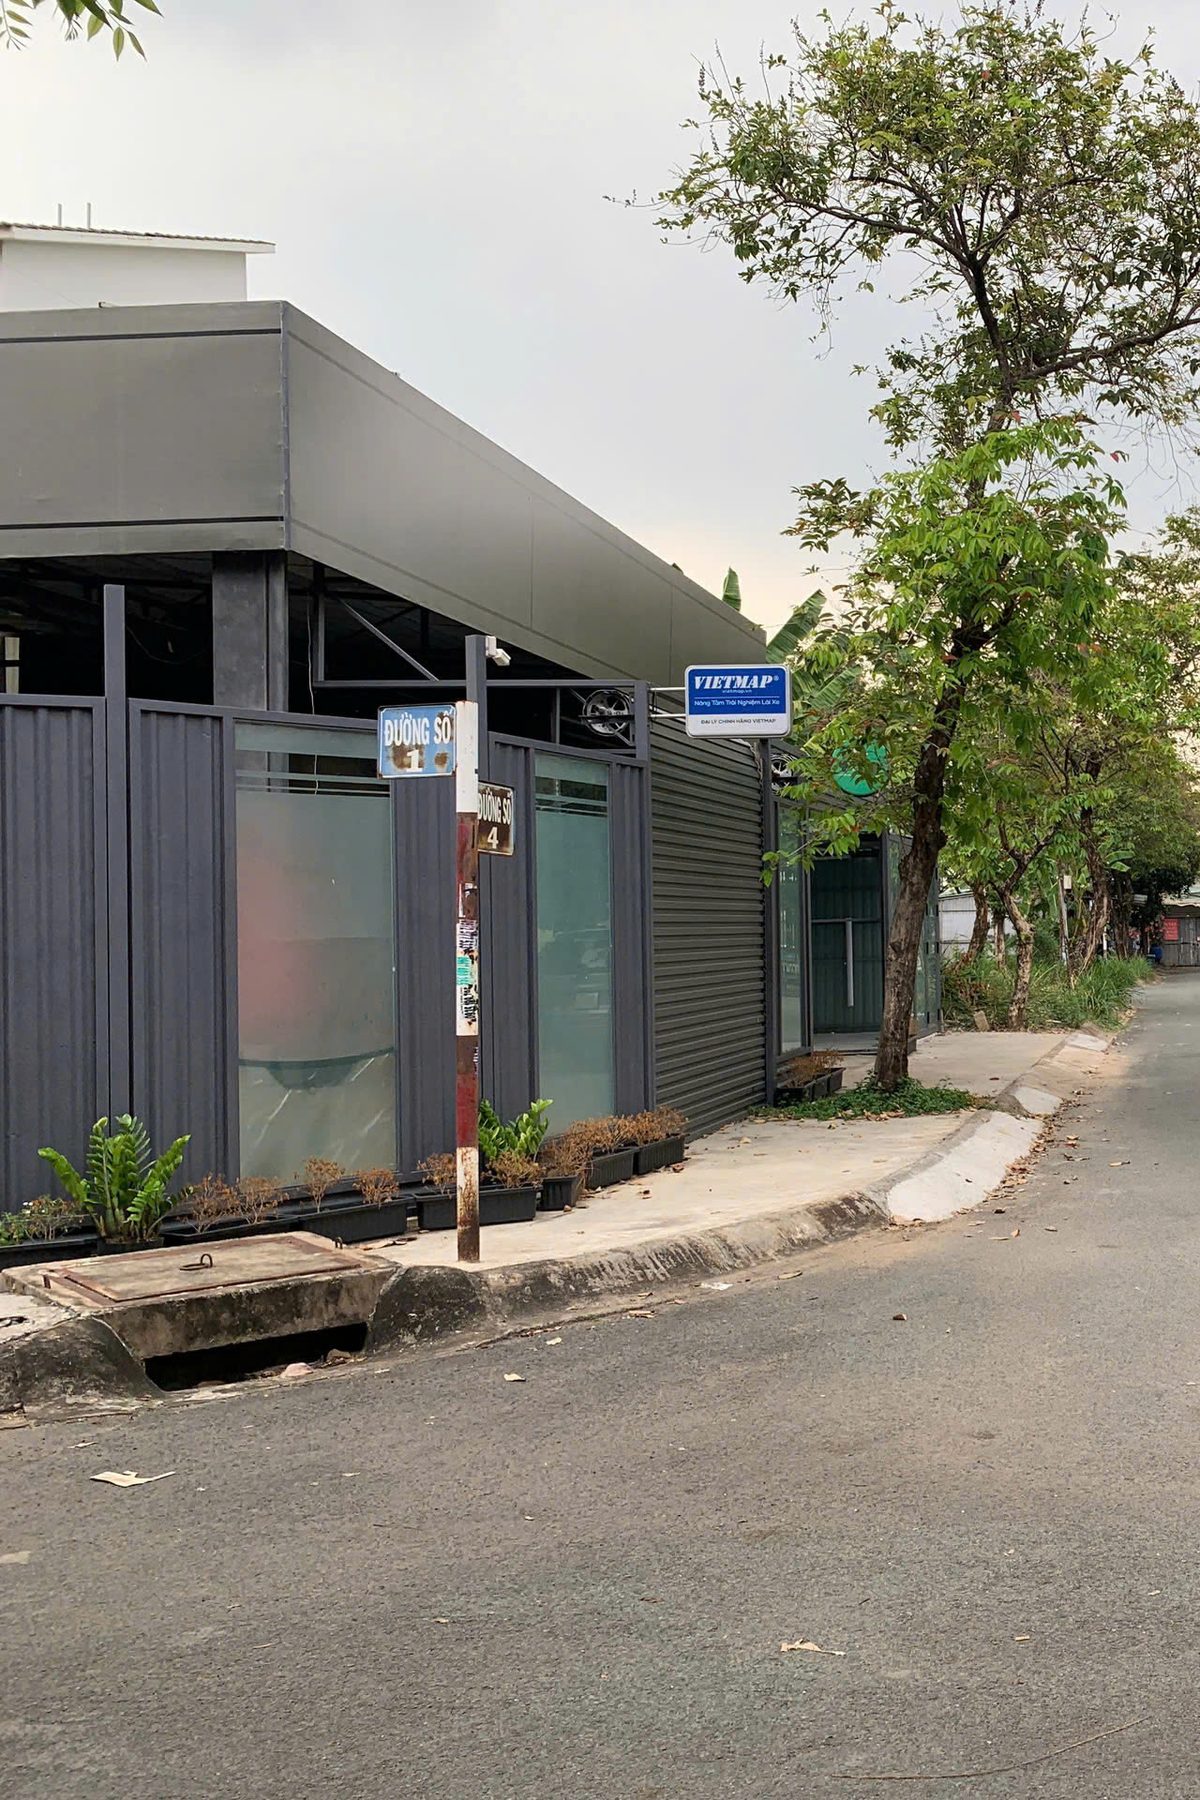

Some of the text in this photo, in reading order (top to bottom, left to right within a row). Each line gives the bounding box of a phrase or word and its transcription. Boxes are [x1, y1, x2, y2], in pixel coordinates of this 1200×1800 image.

[384, 709, 454, 747] ĐƯỜNG SỐ
[406, 749, 423, 772] 1
[487, 826, 499, 849] 4
